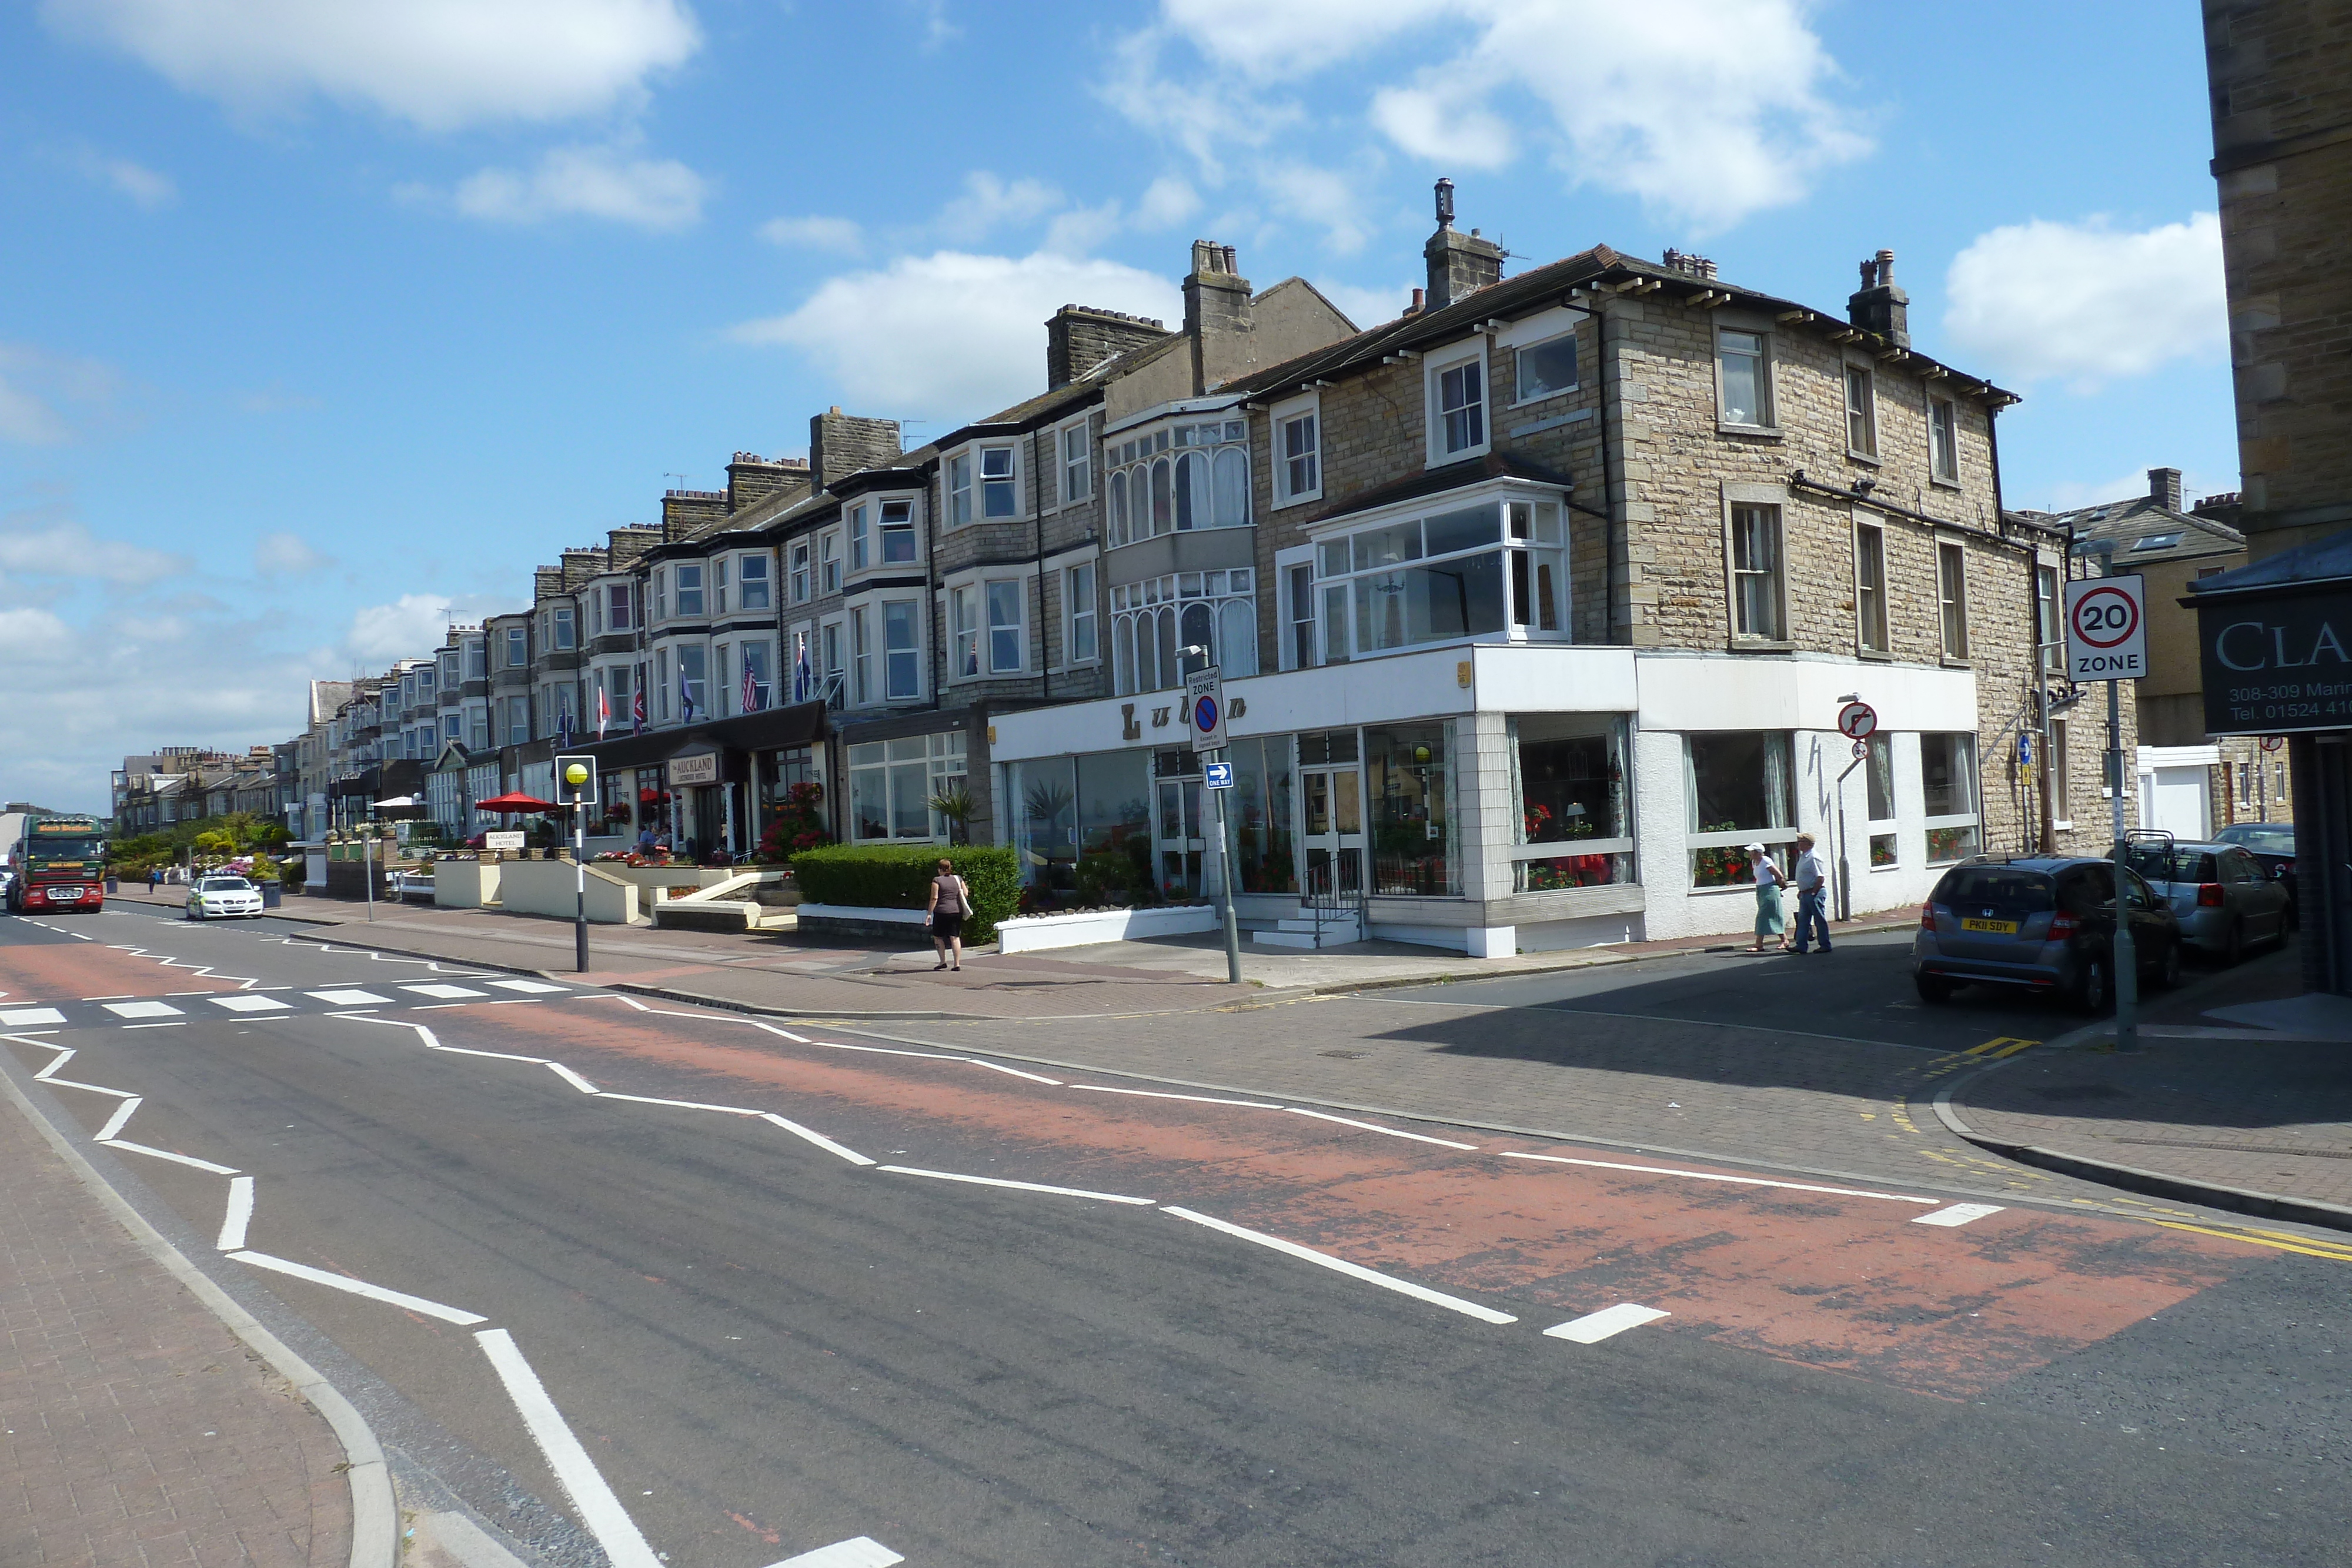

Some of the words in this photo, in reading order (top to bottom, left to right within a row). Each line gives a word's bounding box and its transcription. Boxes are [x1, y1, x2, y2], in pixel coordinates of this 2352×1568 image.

[2083, 604, 2127, 631] 20
[2216, 621, 2352, 671] CLA
[2079, 654, 2139, 673] ZONE
[1188, 670, 1217, 684] Restricted
[1193, 682, 1214, 695] ZONE
[2230, 684, 2300, 702] 308-309
[2230, 707, 2259, 720] Tel.
[2266, 703, 2319, 718] 01524
[677, 758, 712, 774] AUCKLAND
[1990, 921, 2009, 931] SDY
